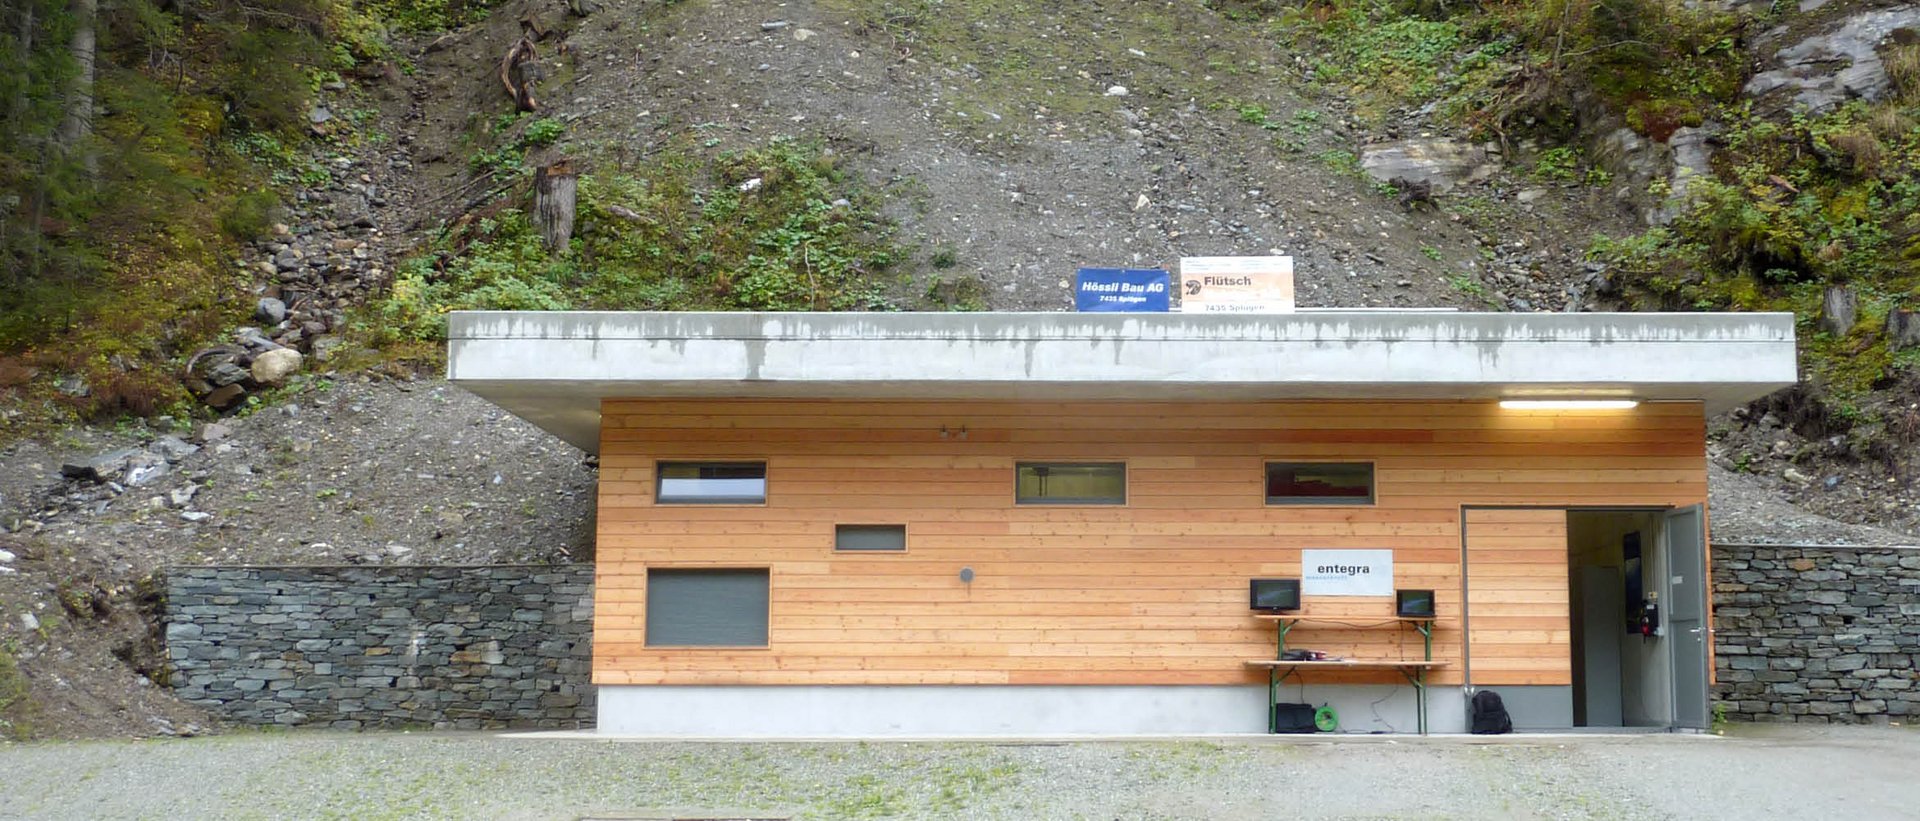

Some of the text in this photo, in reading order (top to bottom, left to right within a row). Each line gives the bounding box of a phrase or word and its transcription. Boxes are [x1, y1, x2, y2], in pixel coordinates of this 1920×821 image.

[1204, 276, 1251, 286] Flütsch
[1082, 281, 1164, 293] Hössli Bau AG
[1205, 304, 1226, 312] 7435
[1317, 564, 1370, 576] entegra
